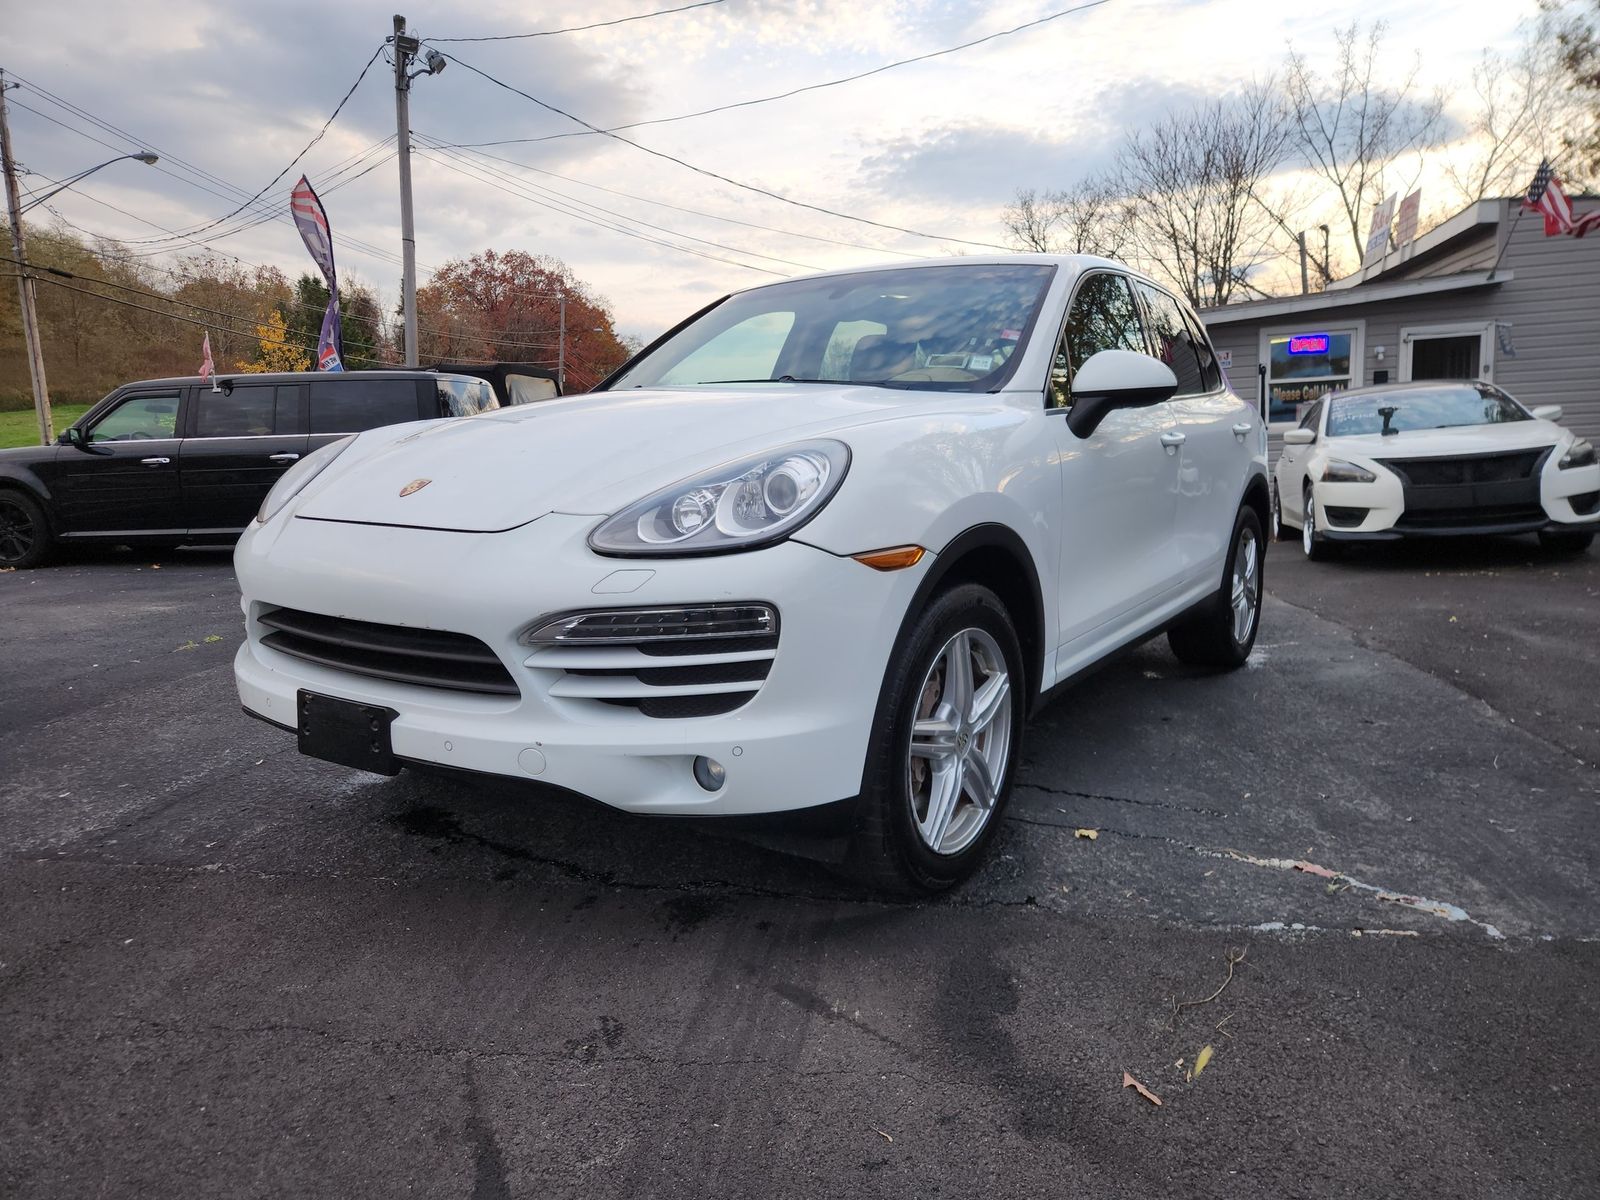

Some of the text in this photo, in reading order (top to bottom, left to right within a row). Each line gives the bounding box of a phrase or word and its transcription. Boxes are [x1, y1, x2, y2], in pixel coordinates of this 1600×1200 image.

[1290, 338, 1326, 352] OPEN
[1273, 386, 1301, 400] Please
[1303, 385, 1319, 400] Call
